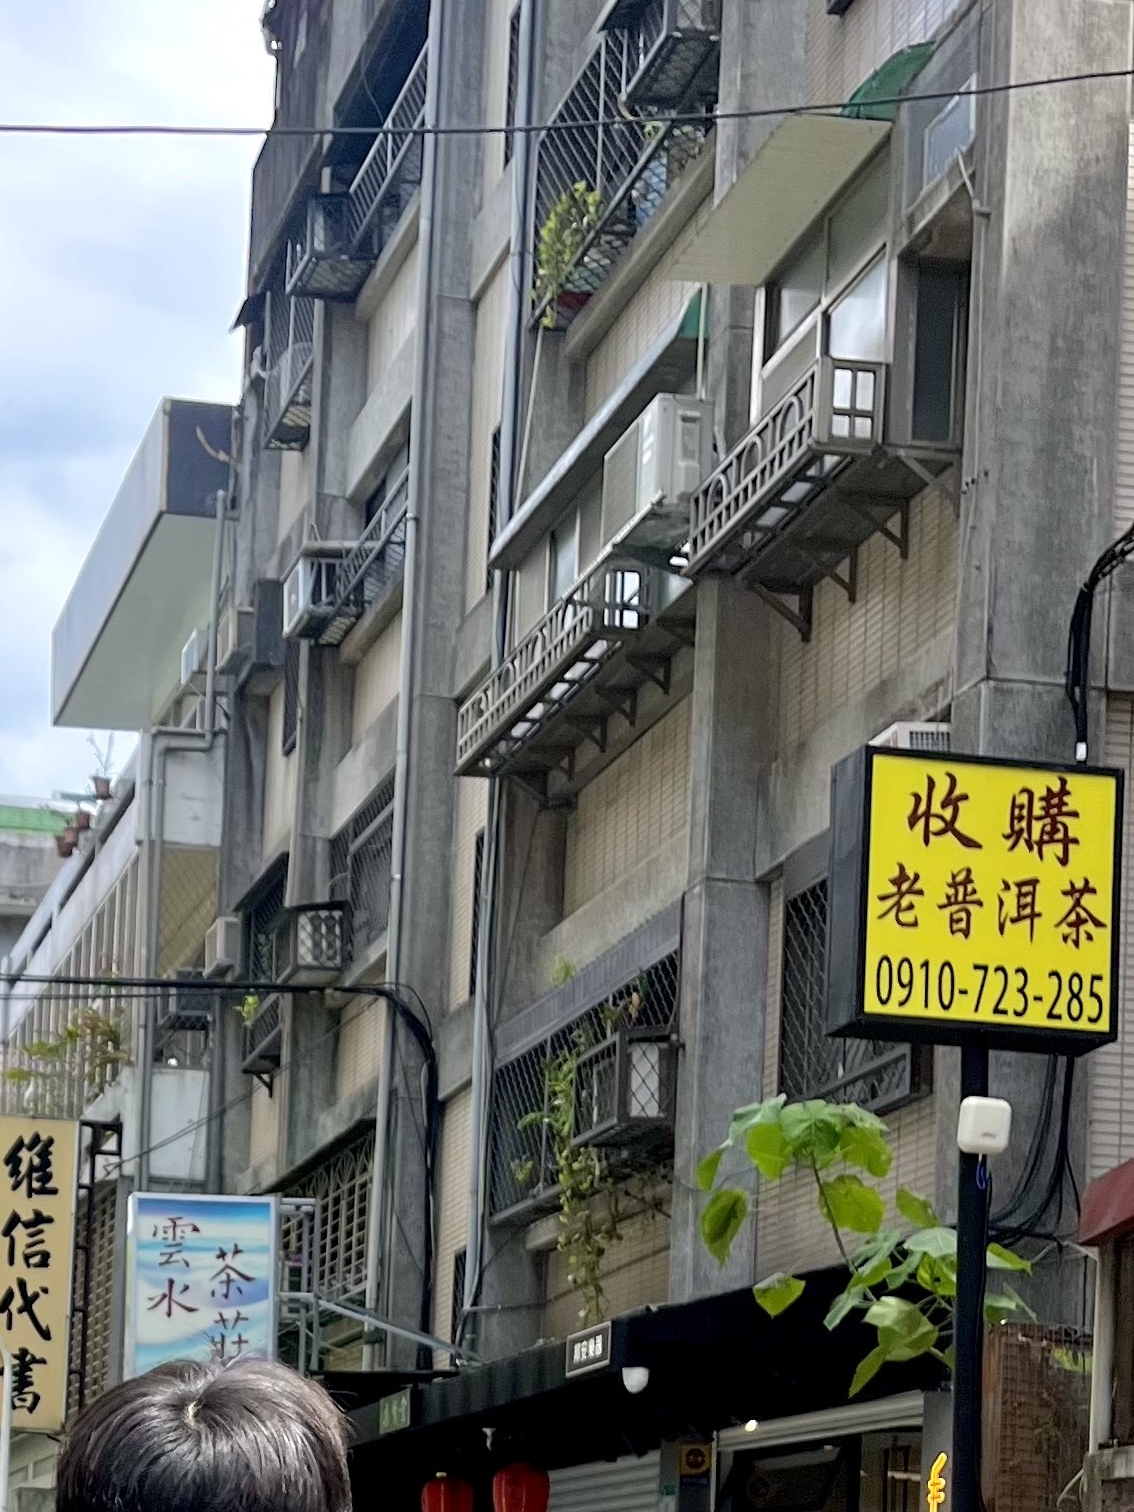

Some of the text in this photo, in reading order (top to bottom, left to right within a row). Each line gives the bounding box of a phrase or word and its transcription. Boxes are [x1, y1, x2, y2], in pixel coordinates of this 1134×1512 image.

[907, 772, 1080, 867] 收購
[877, 862, 1107, 949] 老普洱茶
[875, 955, 1104, 1024] 0910-723-285
[147, 1217, 200, 1318] 雲水
